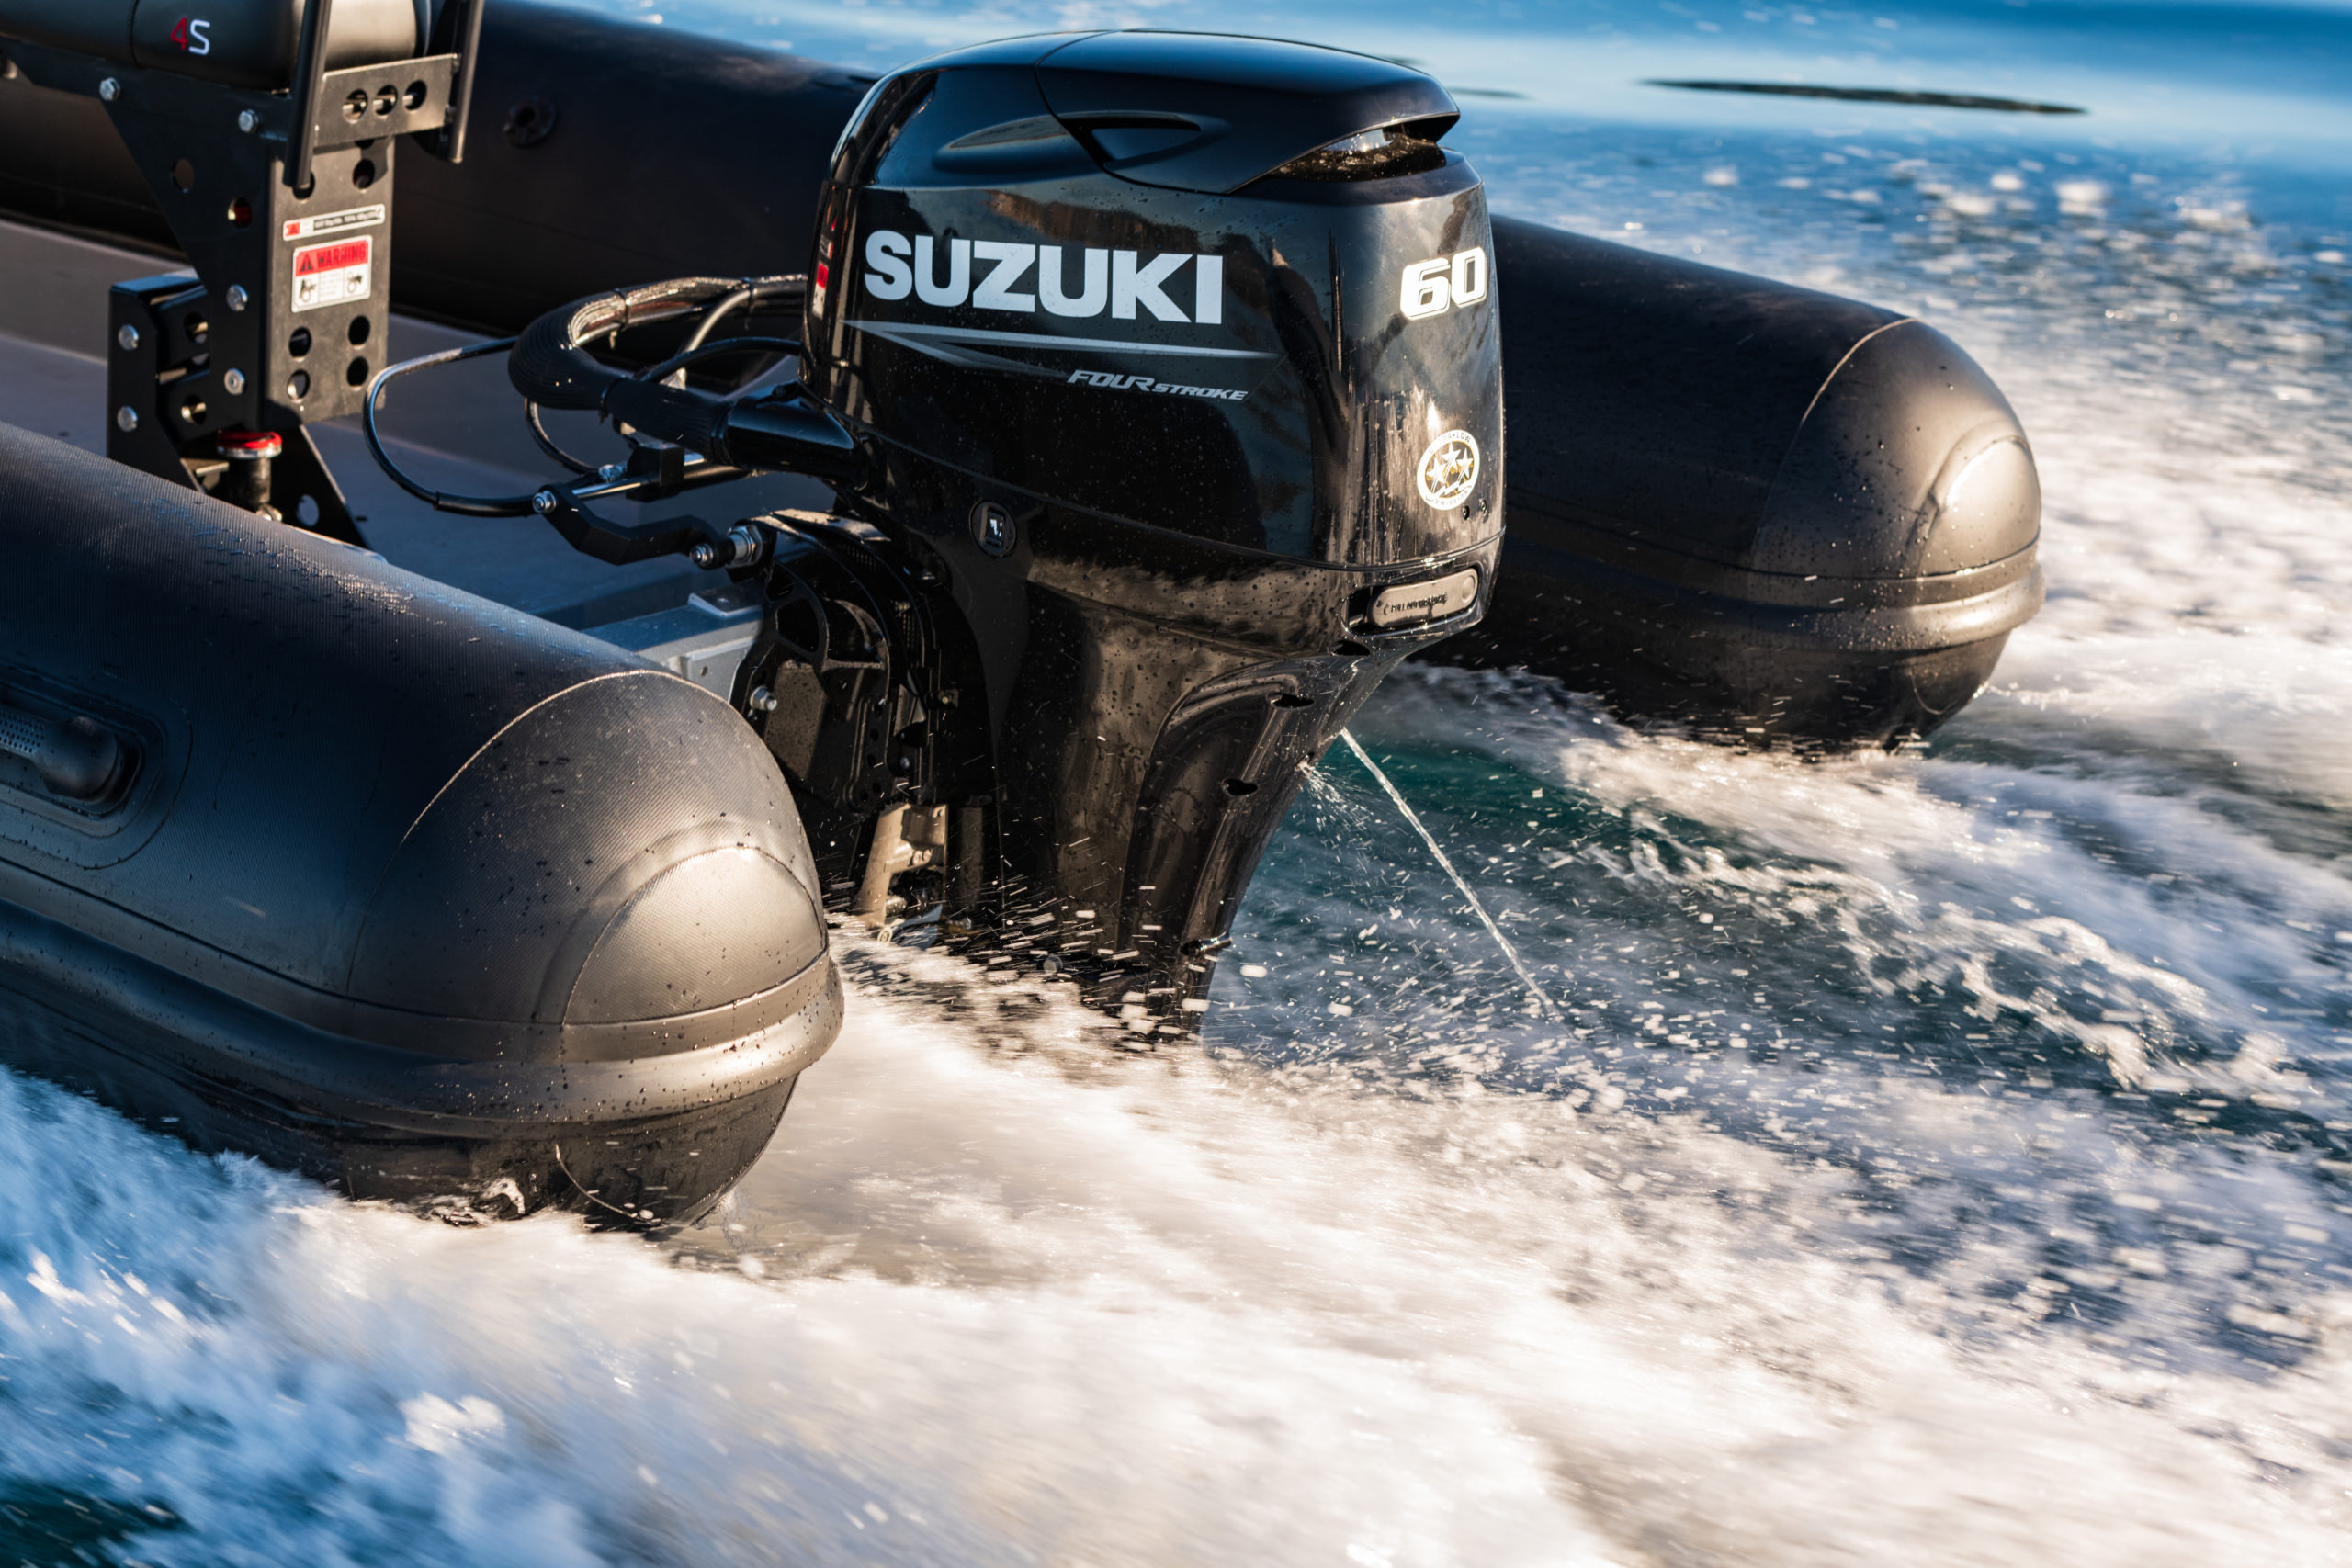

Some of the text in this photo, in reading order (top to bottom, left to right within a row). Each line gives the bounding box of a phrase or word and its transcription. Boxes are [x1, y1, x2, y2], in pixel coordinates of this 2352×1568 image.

[170, 17, 210, 55] 4S
[316, 242, 367, 269] WARNING
[865, 230, 1223, 324] SUZUKI
[1399, 245, 1487, 321] 60
[1067, 369, 1249, 400] FOUR STROKE
